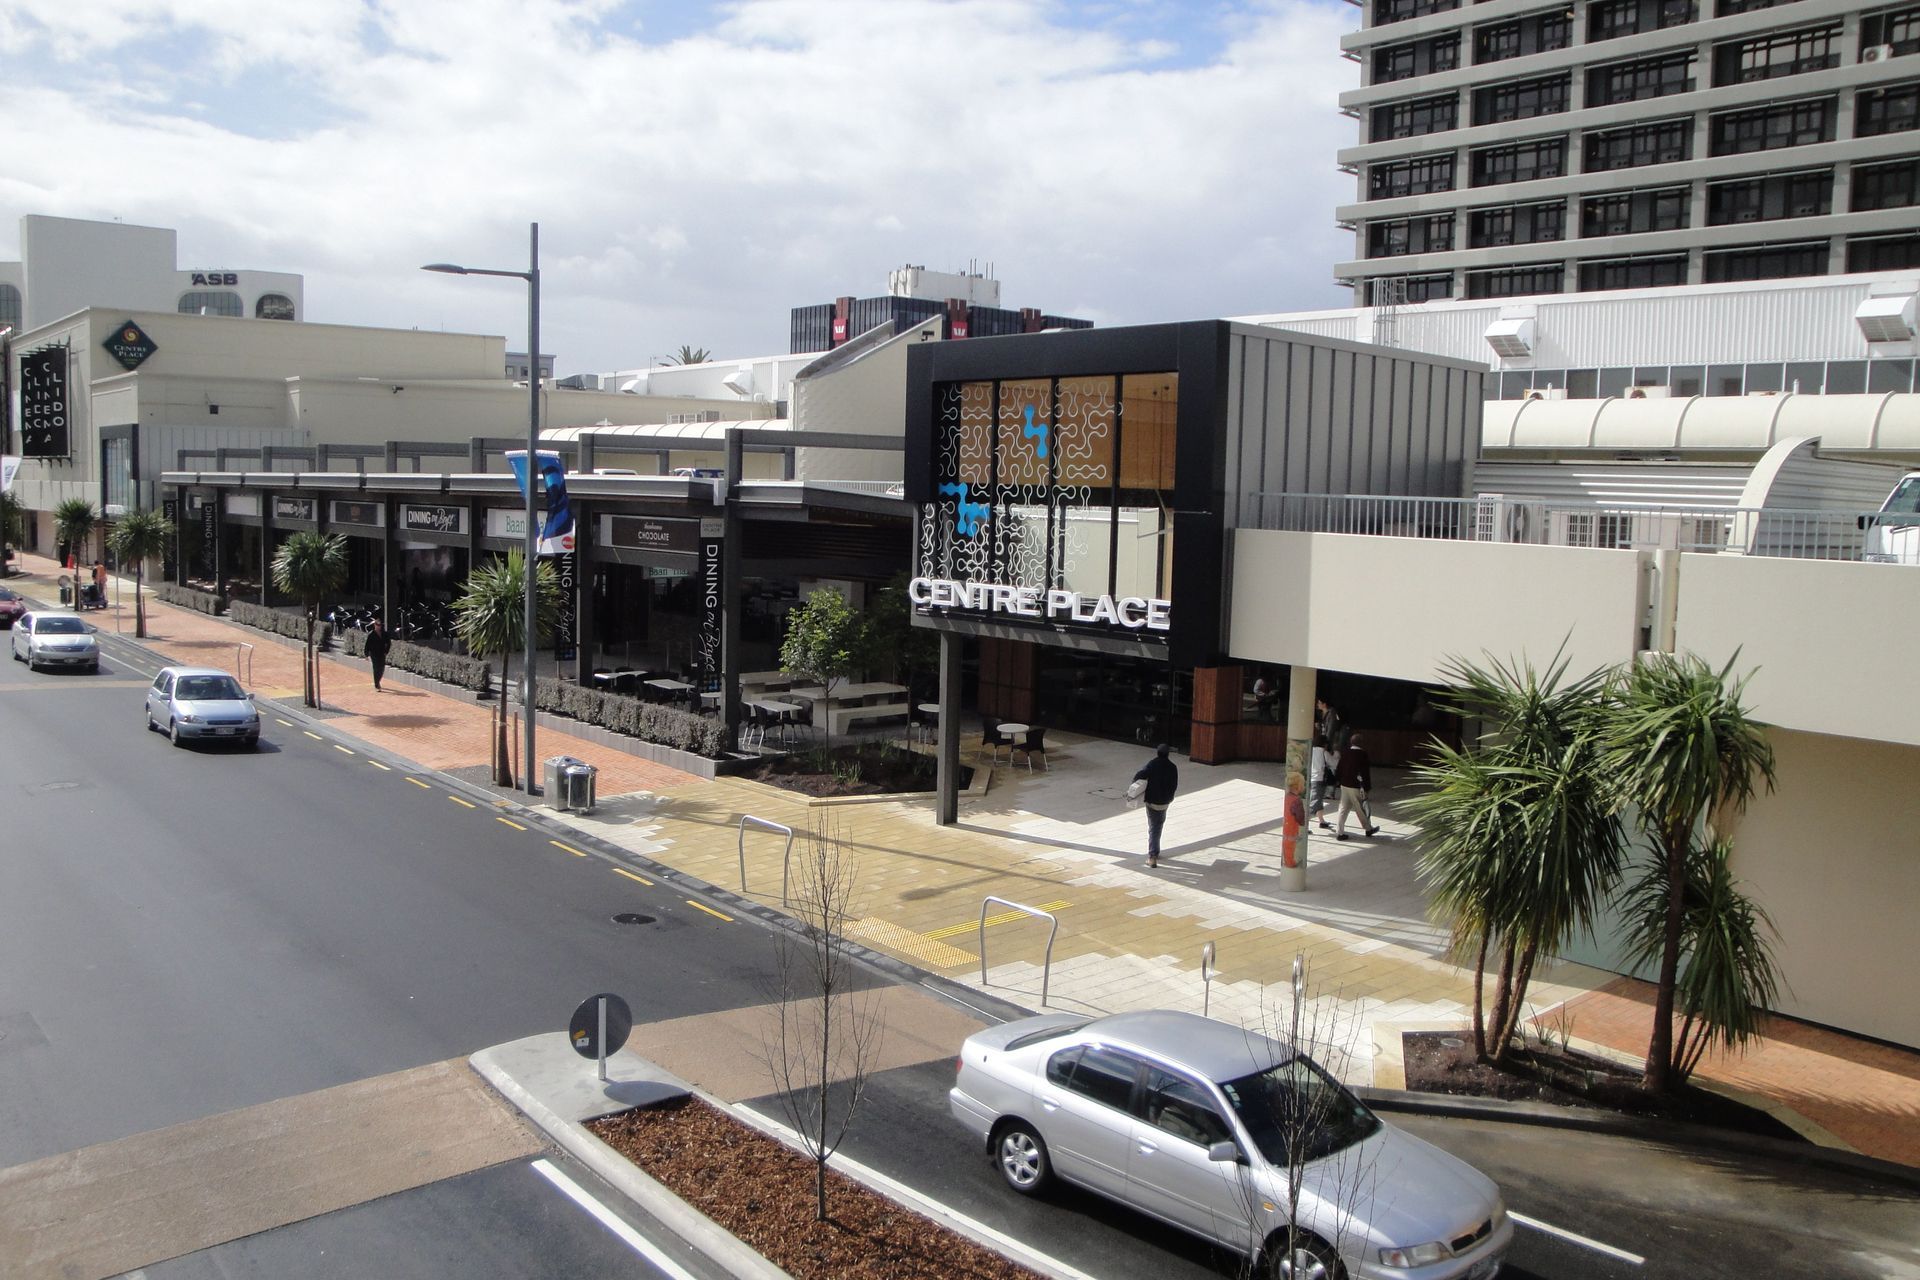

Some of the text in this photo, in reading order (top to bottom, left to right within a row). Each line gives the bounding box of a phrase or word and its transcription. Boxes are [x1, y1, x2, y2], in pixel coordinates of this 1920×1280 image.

[192, 273, 239, 286] ASB
[114, 344, 147, 353] CENTRE
[118, 350, 145, 358] PLACE
[53, 372, 65, 427] LIDO
[204, 505, 213, 539] DINING
[408, 510, 431, 524] DINING
[506, 515, 526, 533] Baan
[561, 552, 573, 588] NING
[699, 544, 721, 672] DINING on Bryce
[909, 577, 1171, 630] CENTRE PLACE
